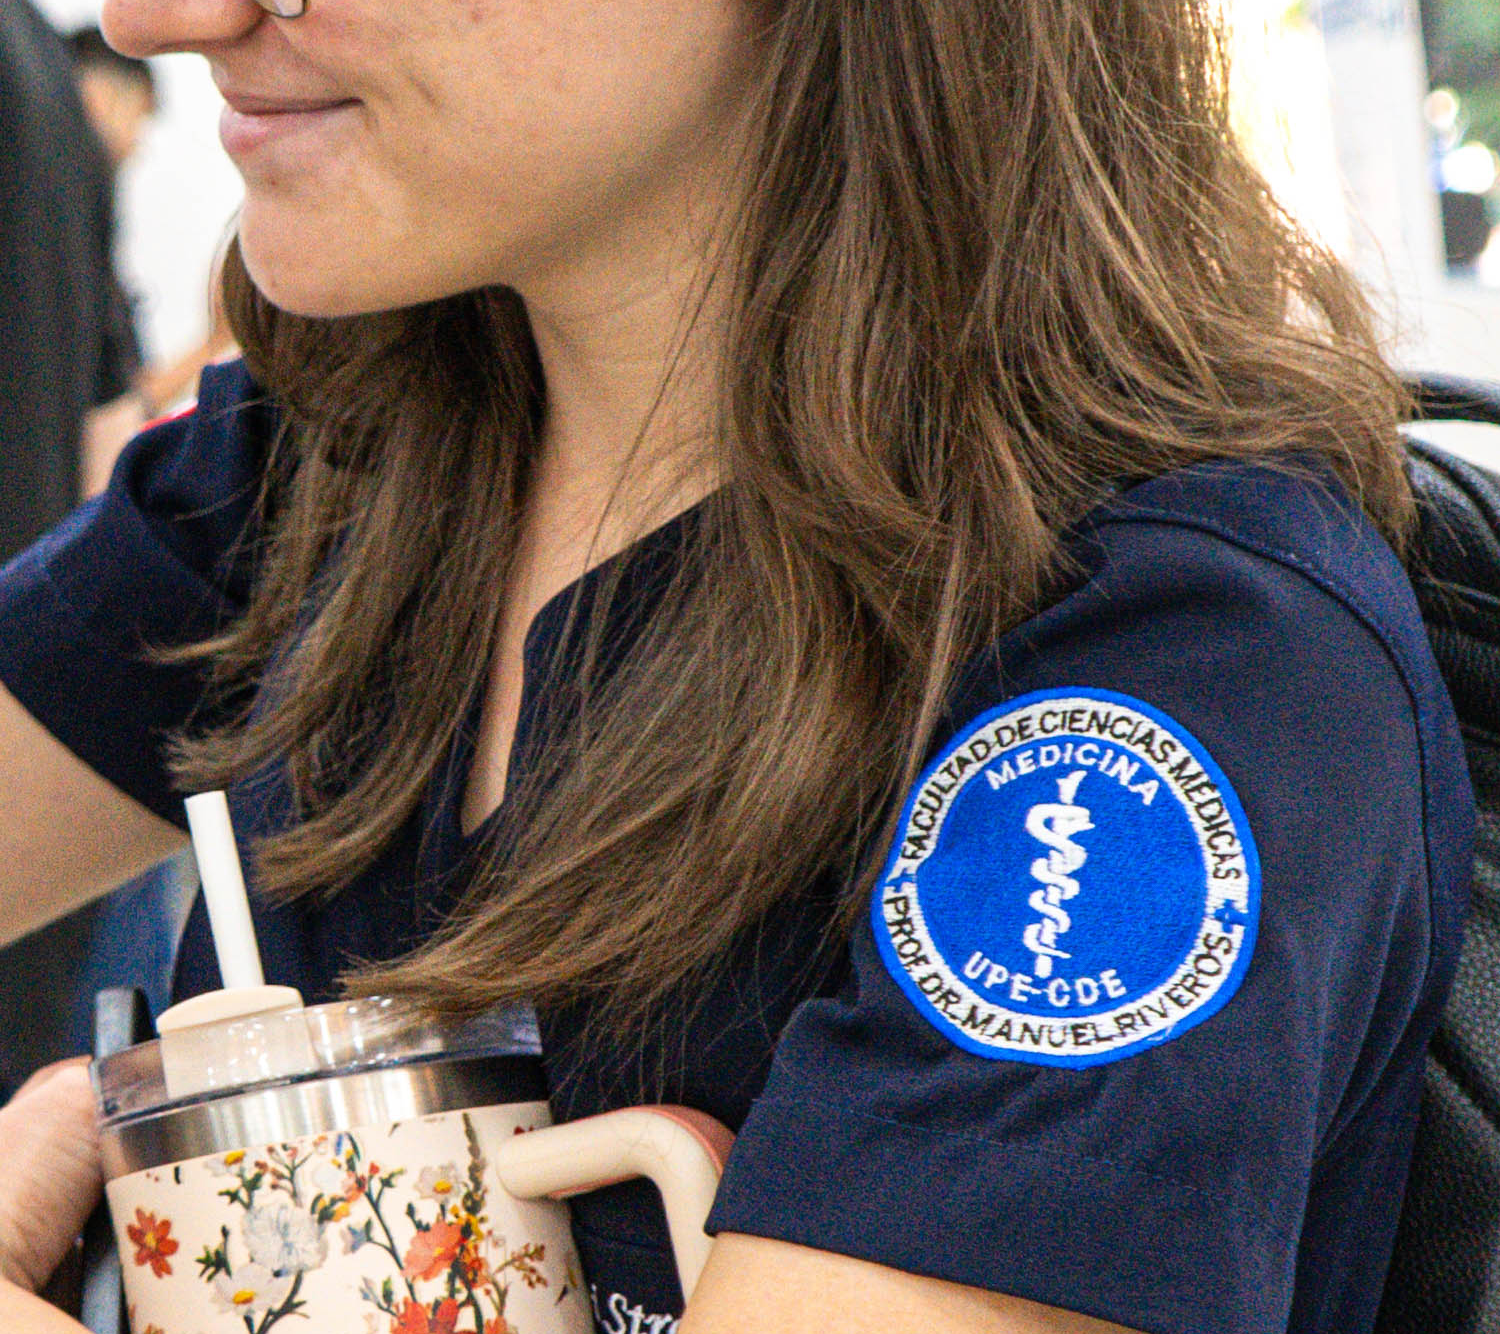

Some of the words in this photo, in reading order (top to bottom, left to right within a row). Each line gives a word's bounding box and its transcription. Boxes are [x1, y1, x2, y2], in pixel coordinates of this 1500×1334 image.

[901, 739, 993, 860] FACULTAD
[994, 716, 1034, 748] DE
[1040, 709, 1177, 764] CIENCIAS
[985, 742, 1159, 806] MEDICINA
[961, 1005, 1113, 1048] MANUEL
[1114, 933, 1232, 1037] RIVEROS
